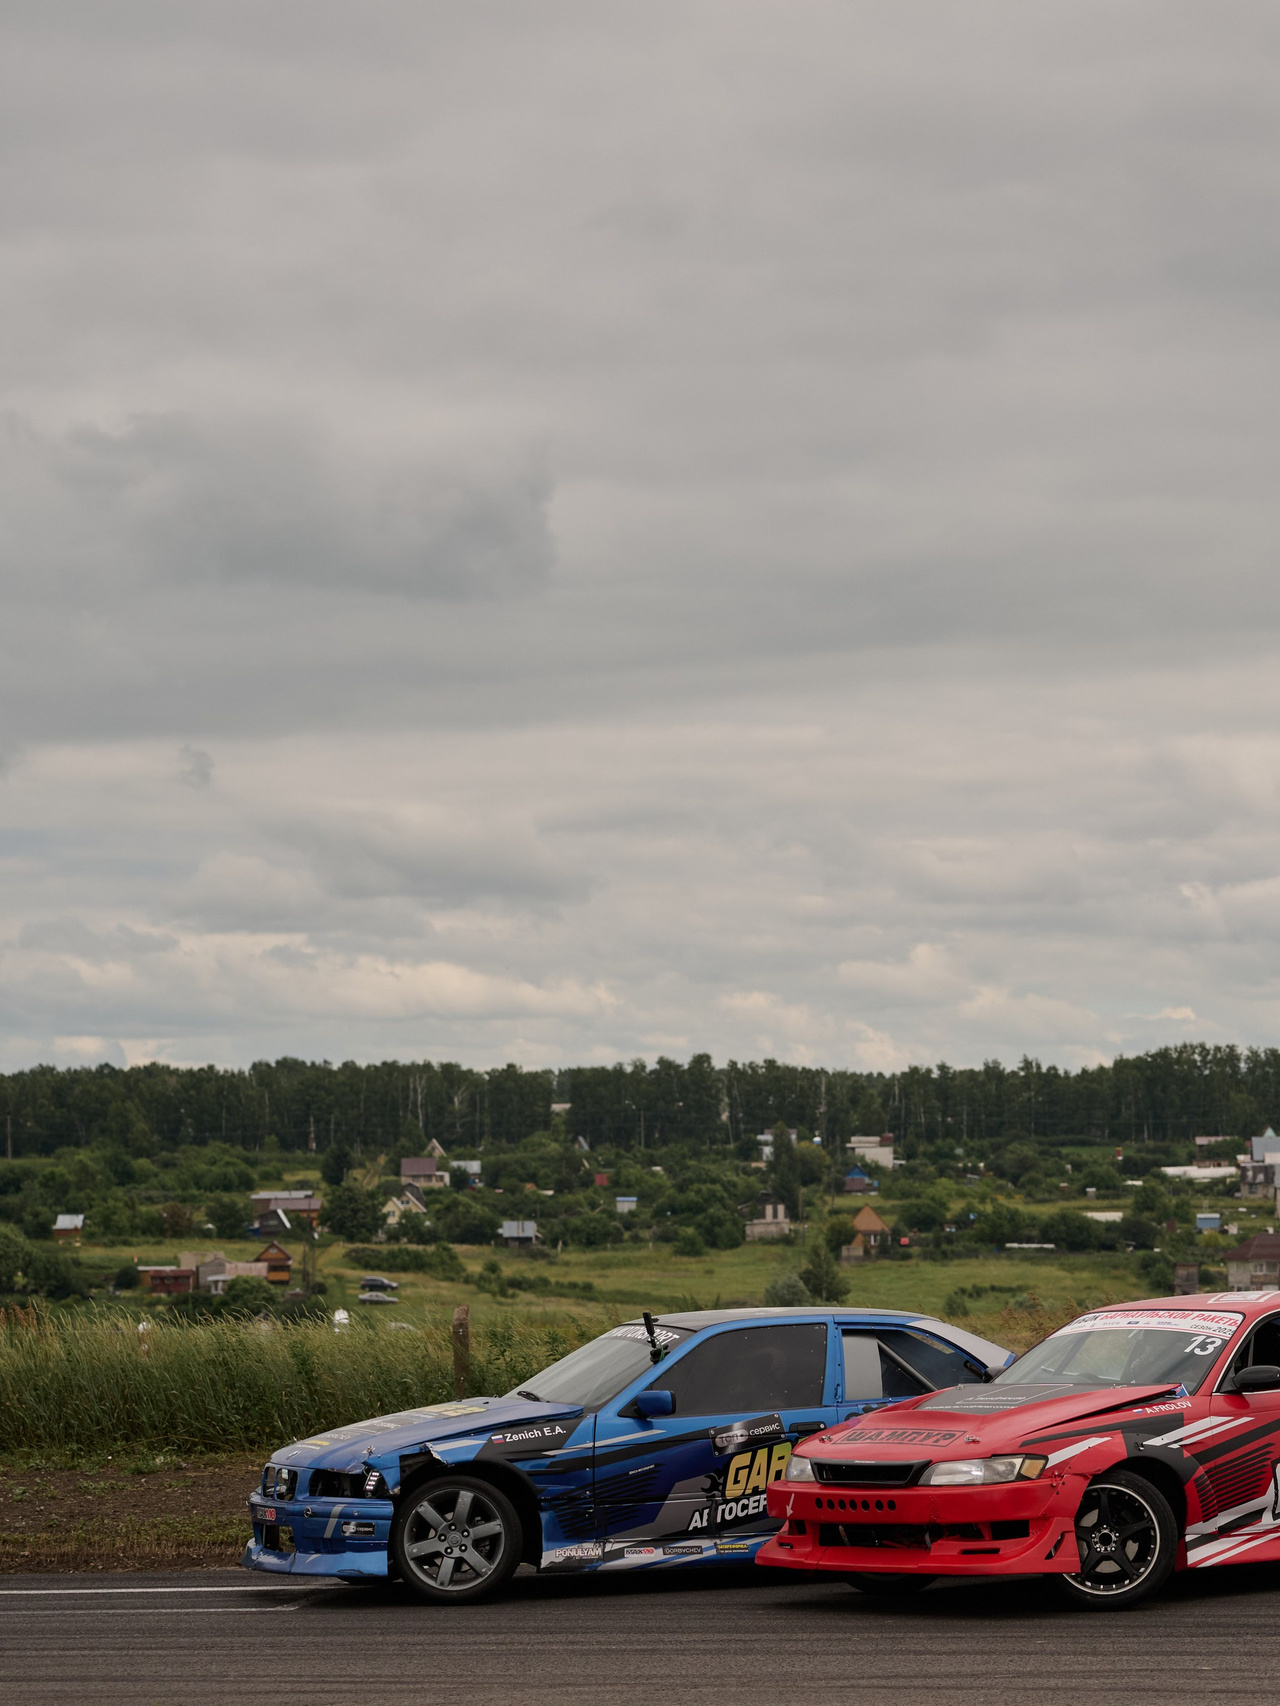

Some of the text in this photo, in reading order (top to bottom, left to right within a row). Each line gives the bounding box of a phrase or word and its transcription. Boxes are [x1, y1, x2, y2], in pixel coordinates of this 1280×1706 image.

[1183, 1335, 1223, 1356] 13
[1144, 1400, 1192, 1414] A.FROLOV
[504, 1425, 567, 1442] Zenich E.A.
[749, 1422, 781, 1436] сервис
[843, 1430, 957, 1444] ШАМПУР
[555, 1547, 602, 1558] PONULYAM
